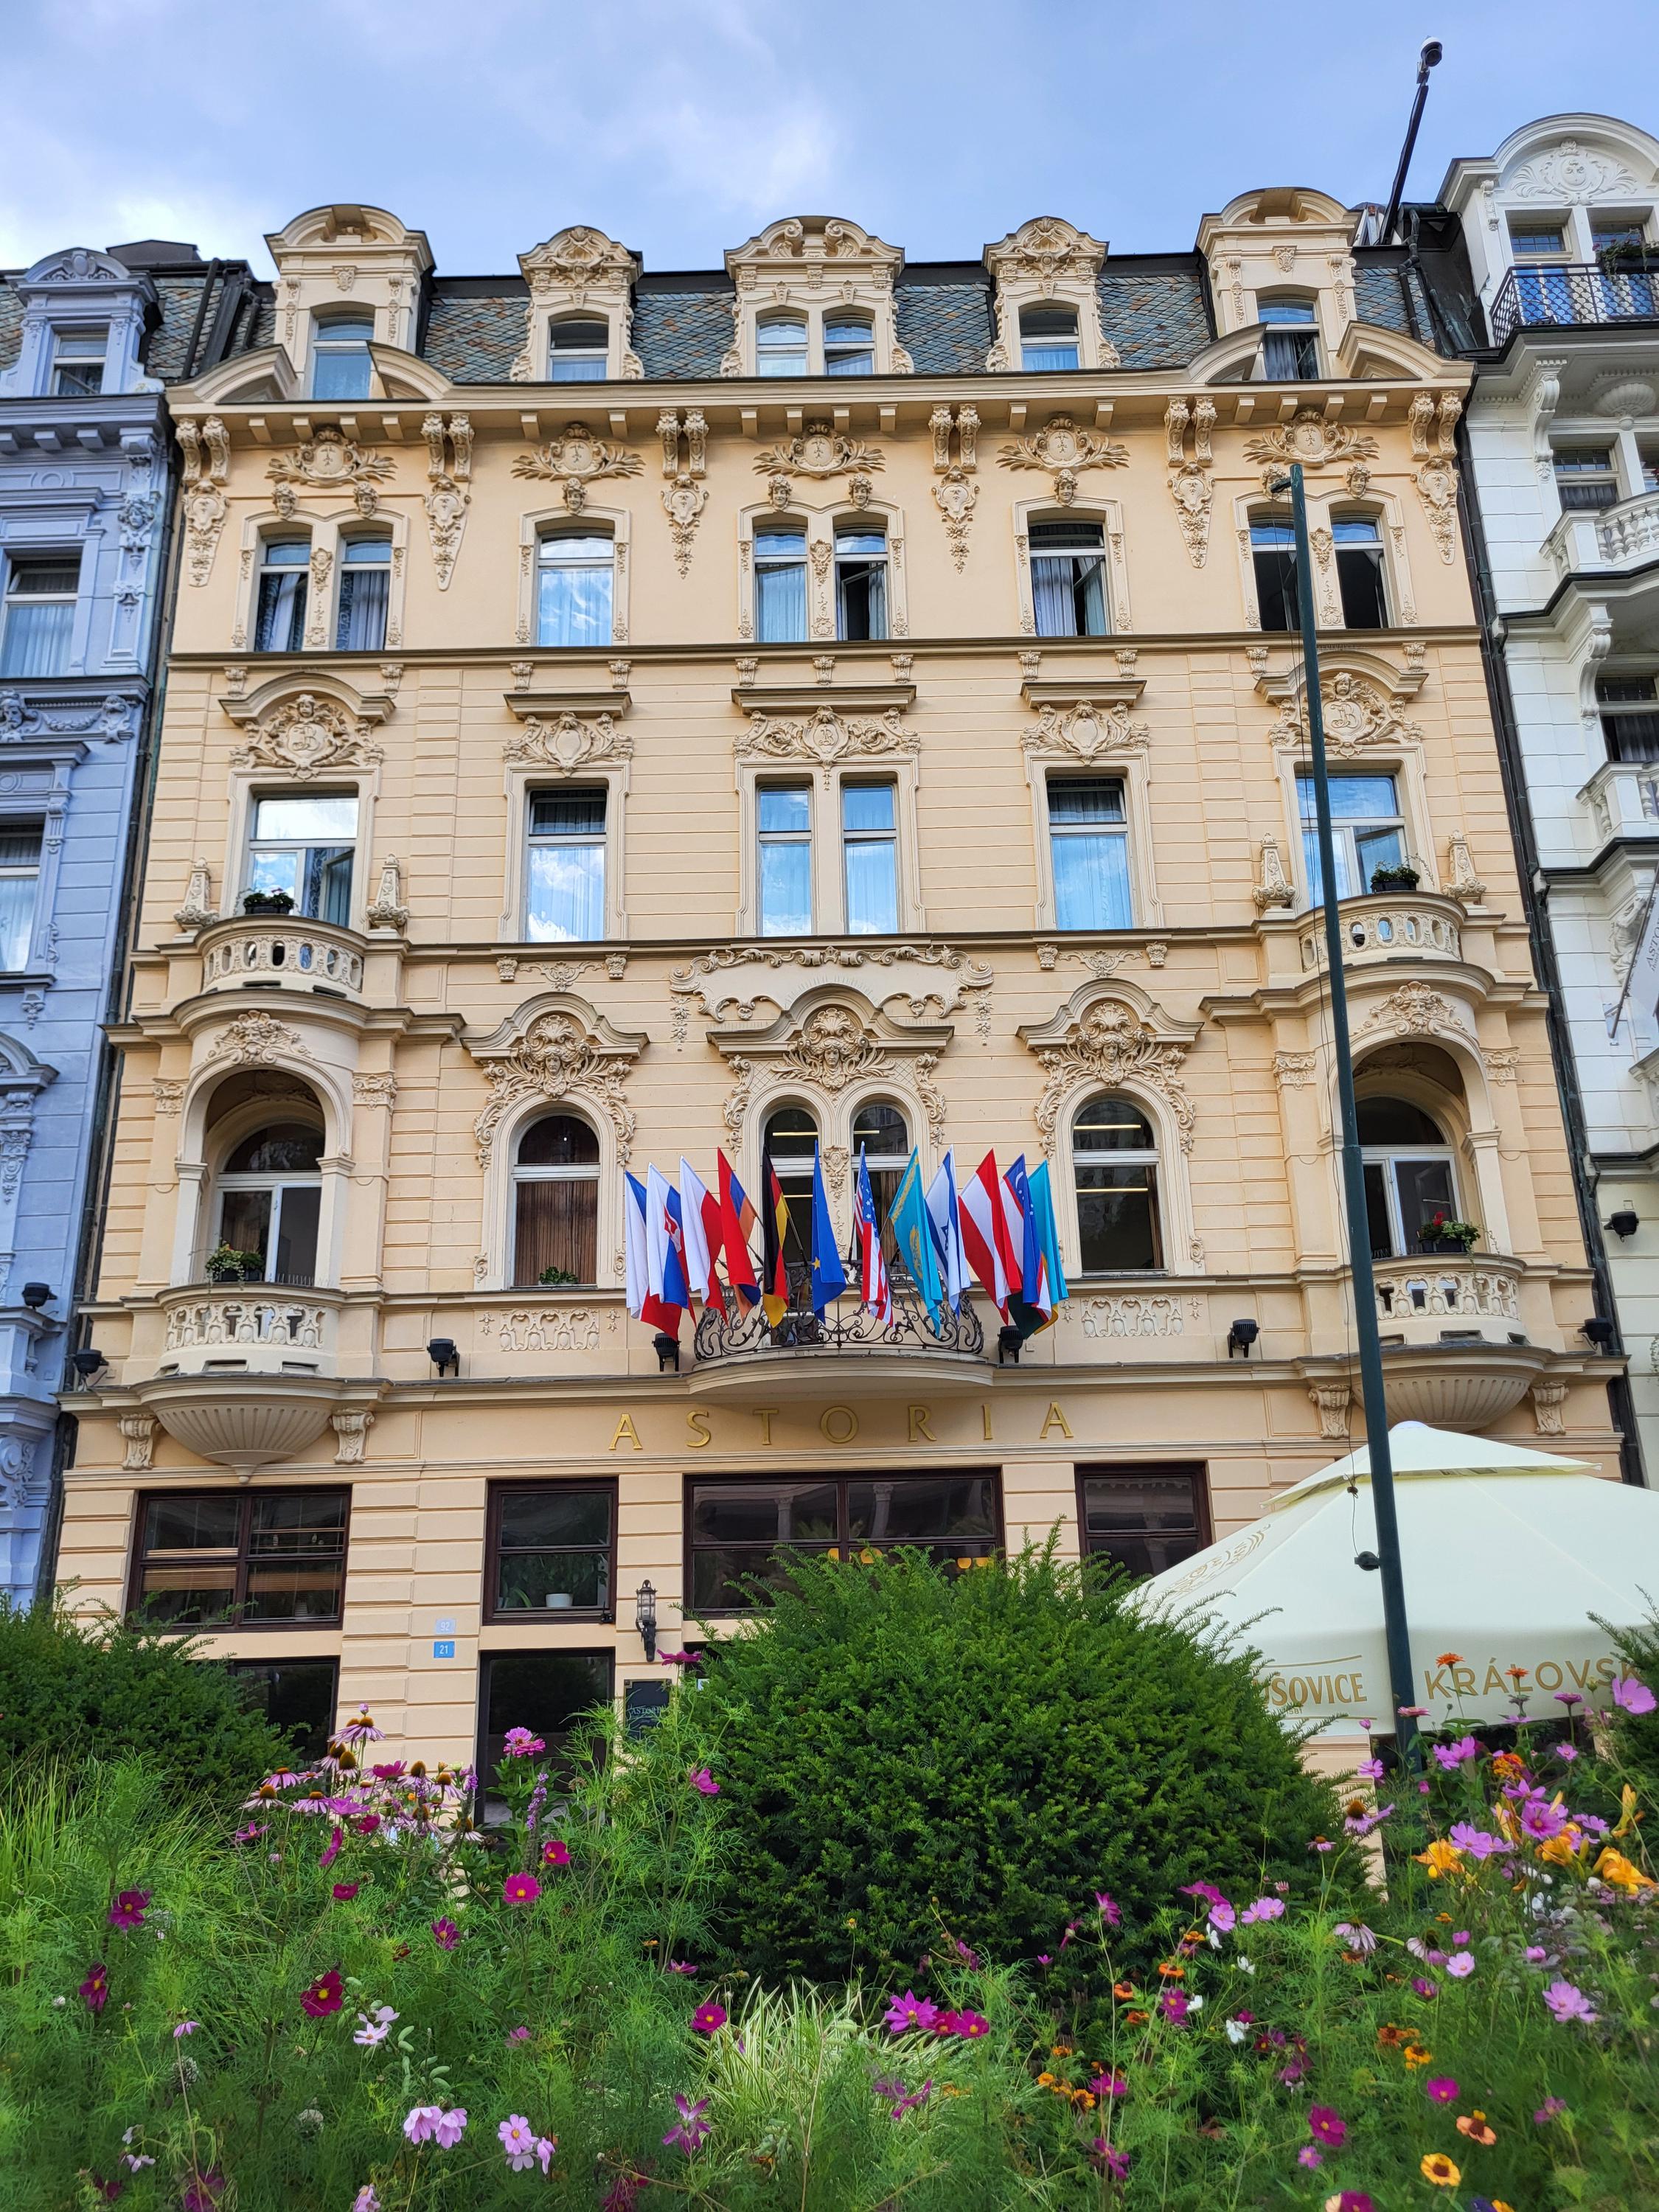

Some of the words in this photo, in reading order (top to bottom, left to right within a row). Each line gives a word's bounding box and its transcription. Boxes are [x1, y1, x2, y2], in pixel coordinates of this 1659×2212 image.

[608, 1401, 1074, 1450] ASTORIA
[440, 1621, 450, 1631] 92
[439, 1644, 448, 1655] 21
[1252, 1672, 1368, 1706] ŠOVICE
